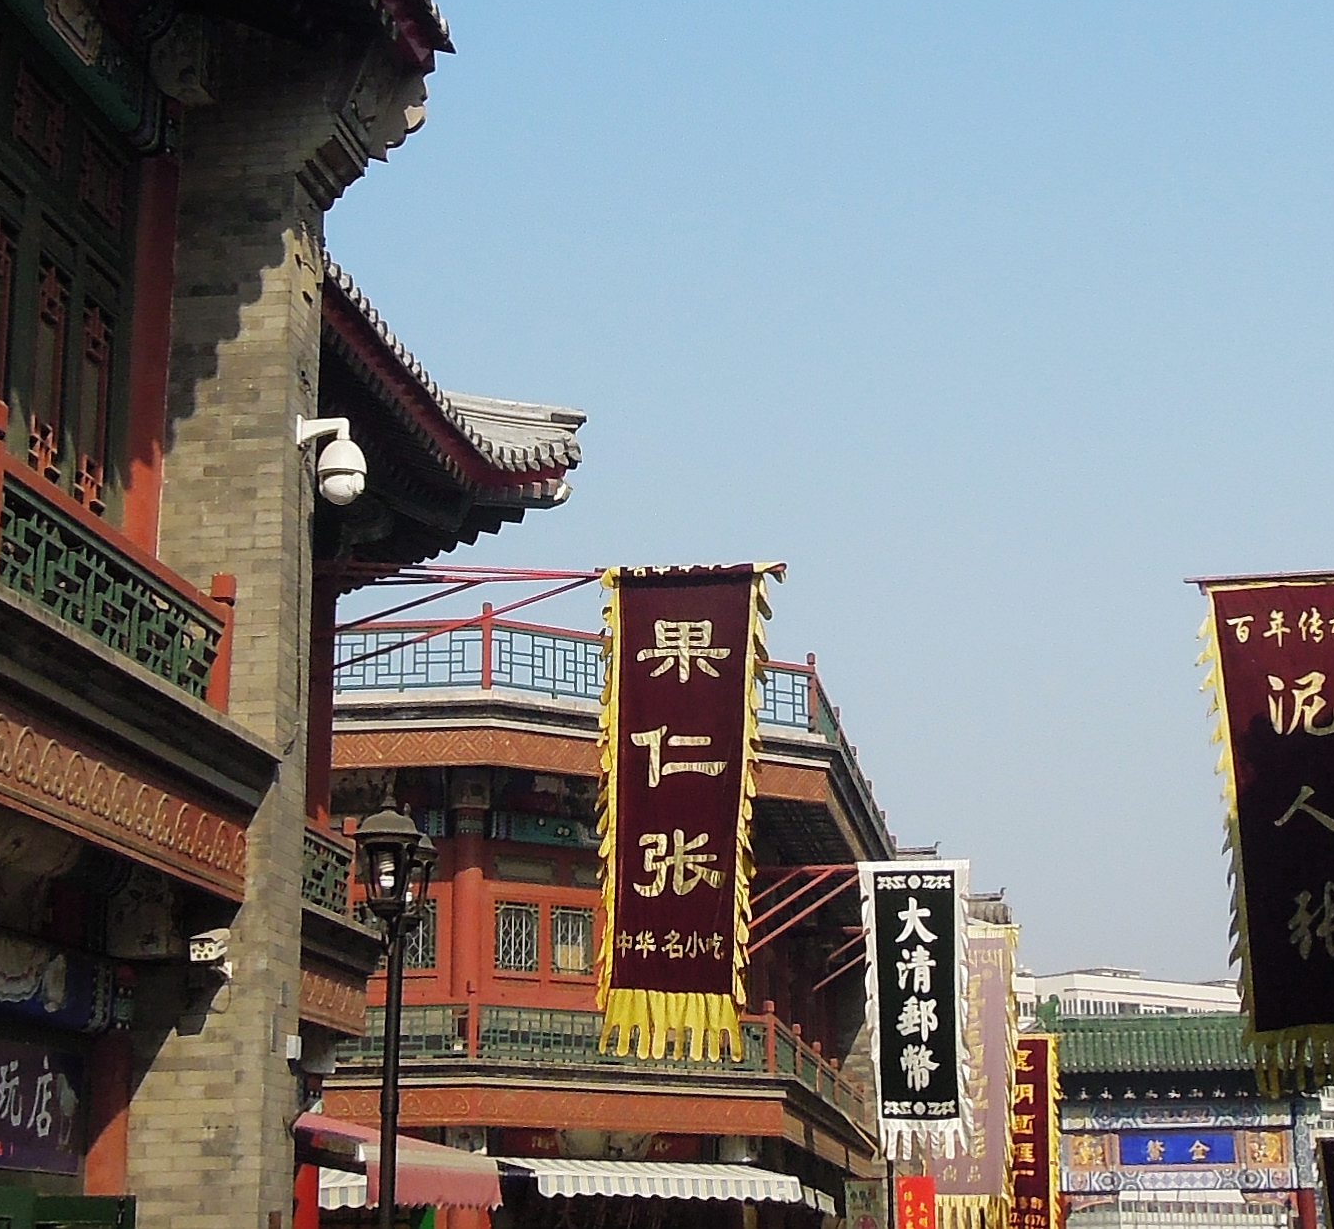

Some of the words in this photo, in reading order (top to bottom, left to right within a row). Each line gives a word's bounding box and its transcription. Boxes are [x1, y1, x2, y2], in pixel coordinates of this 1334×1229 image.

[630, 619, 732, 898] 果仁张
[617, 929, 724, 961] 中华名小吃
[895, 896, 941, 1092] 大清郵幣
